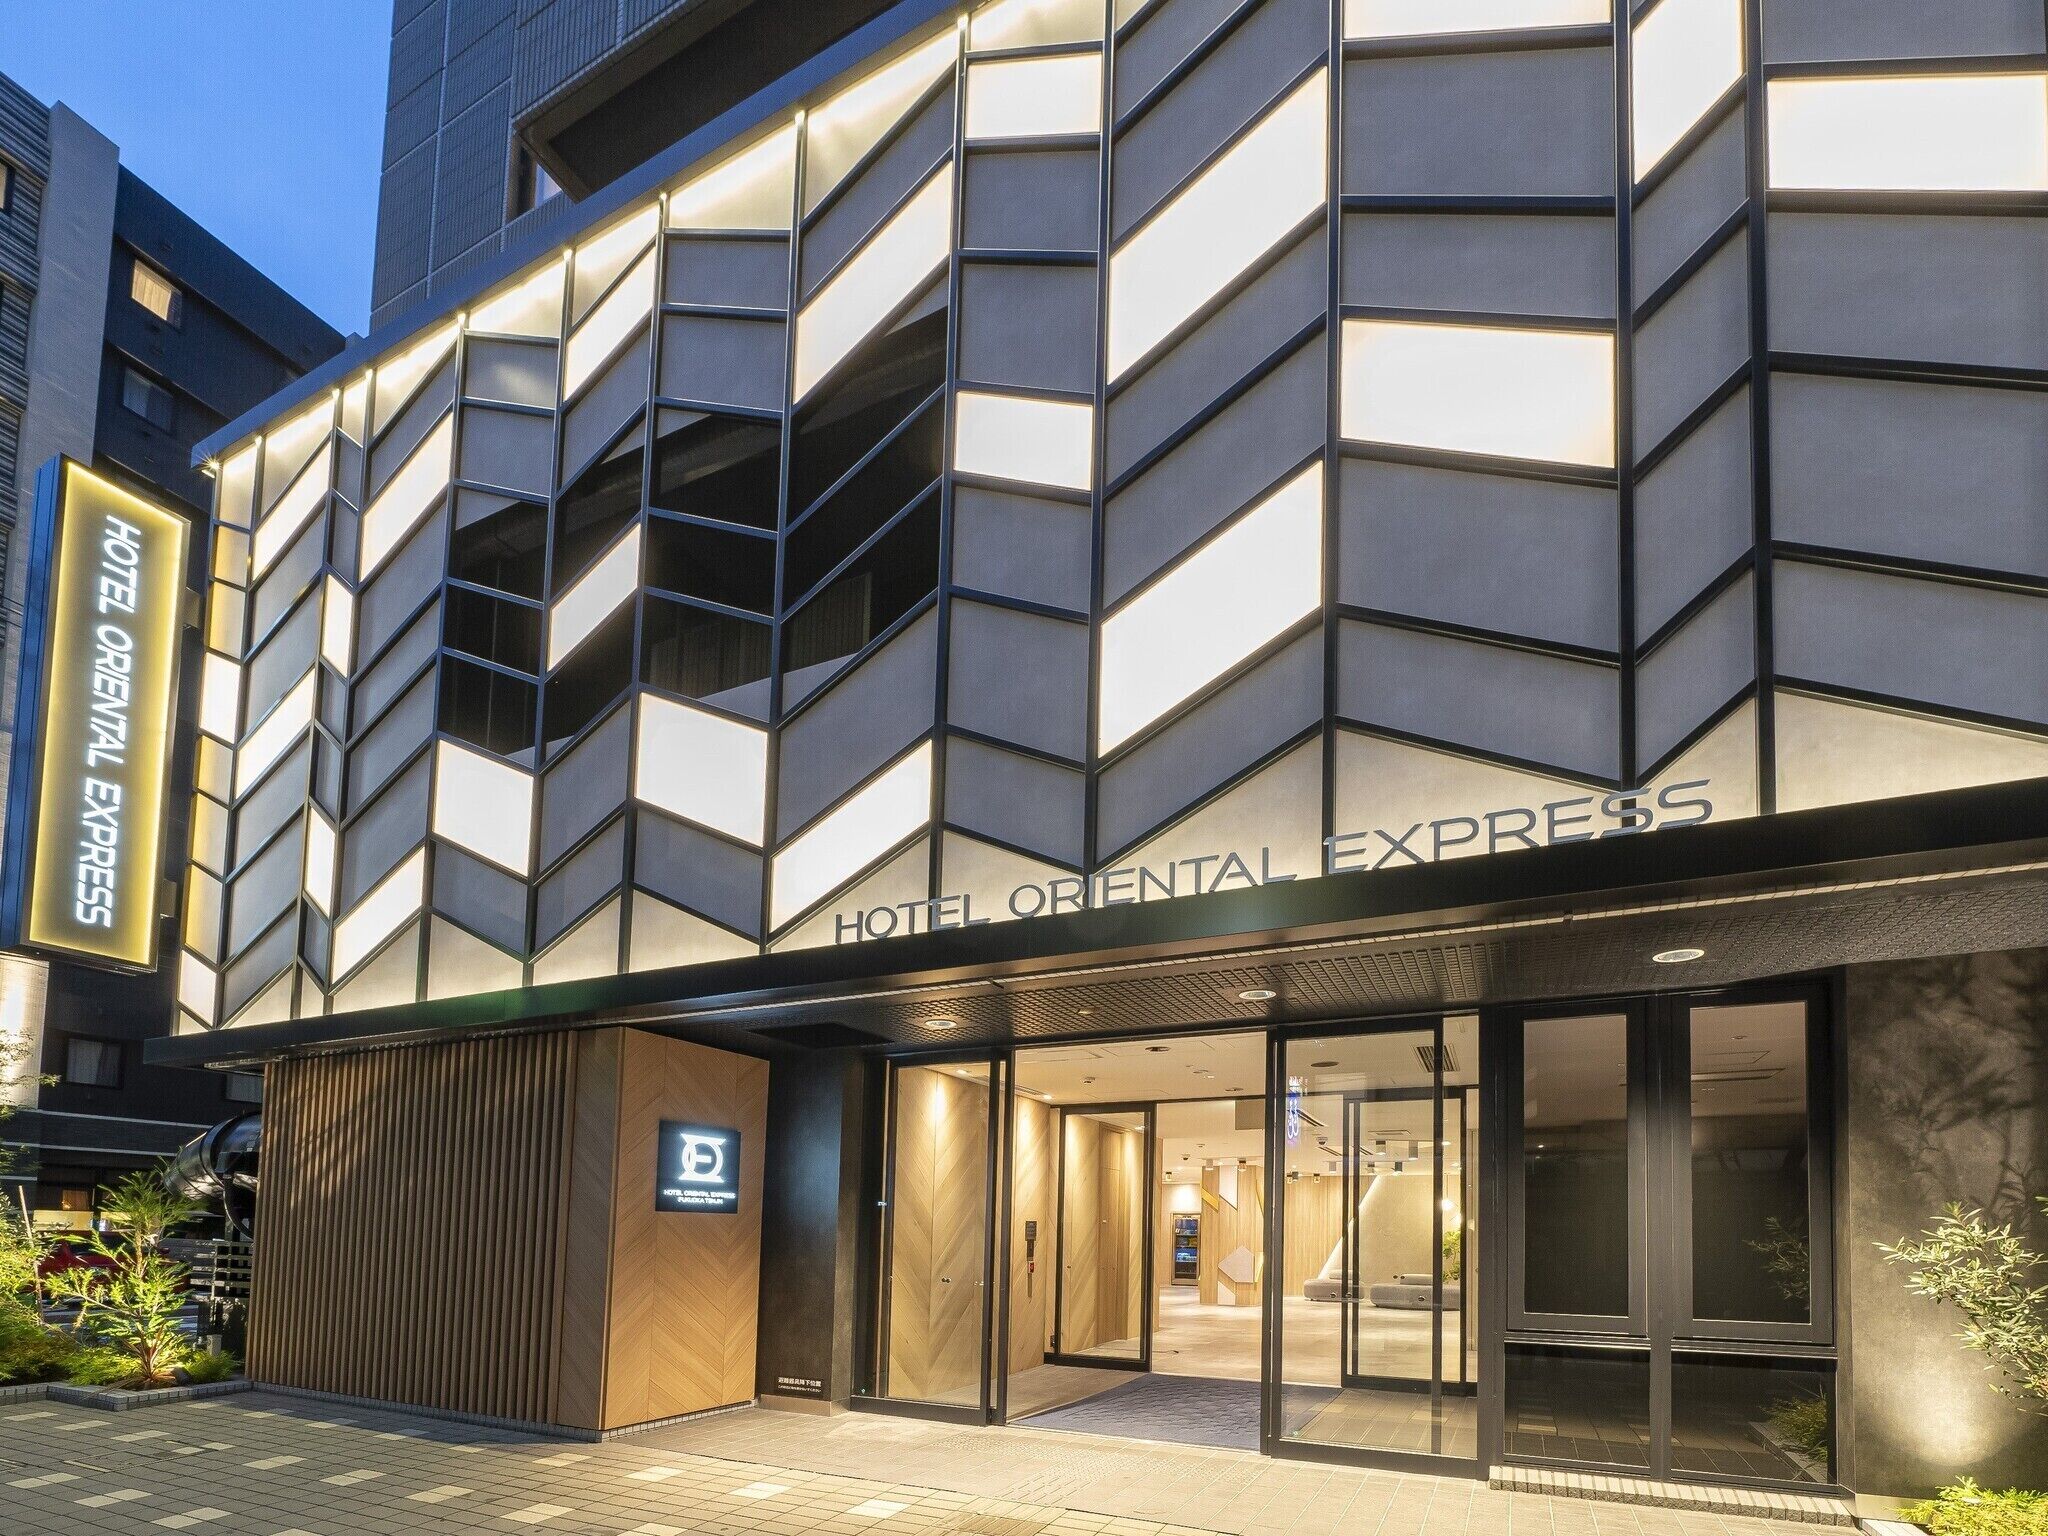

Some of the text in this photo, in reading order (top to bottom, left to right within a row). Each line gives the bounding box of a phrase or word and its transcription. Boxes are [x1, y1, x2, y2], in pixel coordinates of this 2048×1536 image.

[75, 514, 141, 929] HOTEL ORIENTAL EXPRESS
[834, 778, 1713, 945] HOTEL ORIENTAL EXPRESS
[663, 1189, 683, 1197] HOTEL
